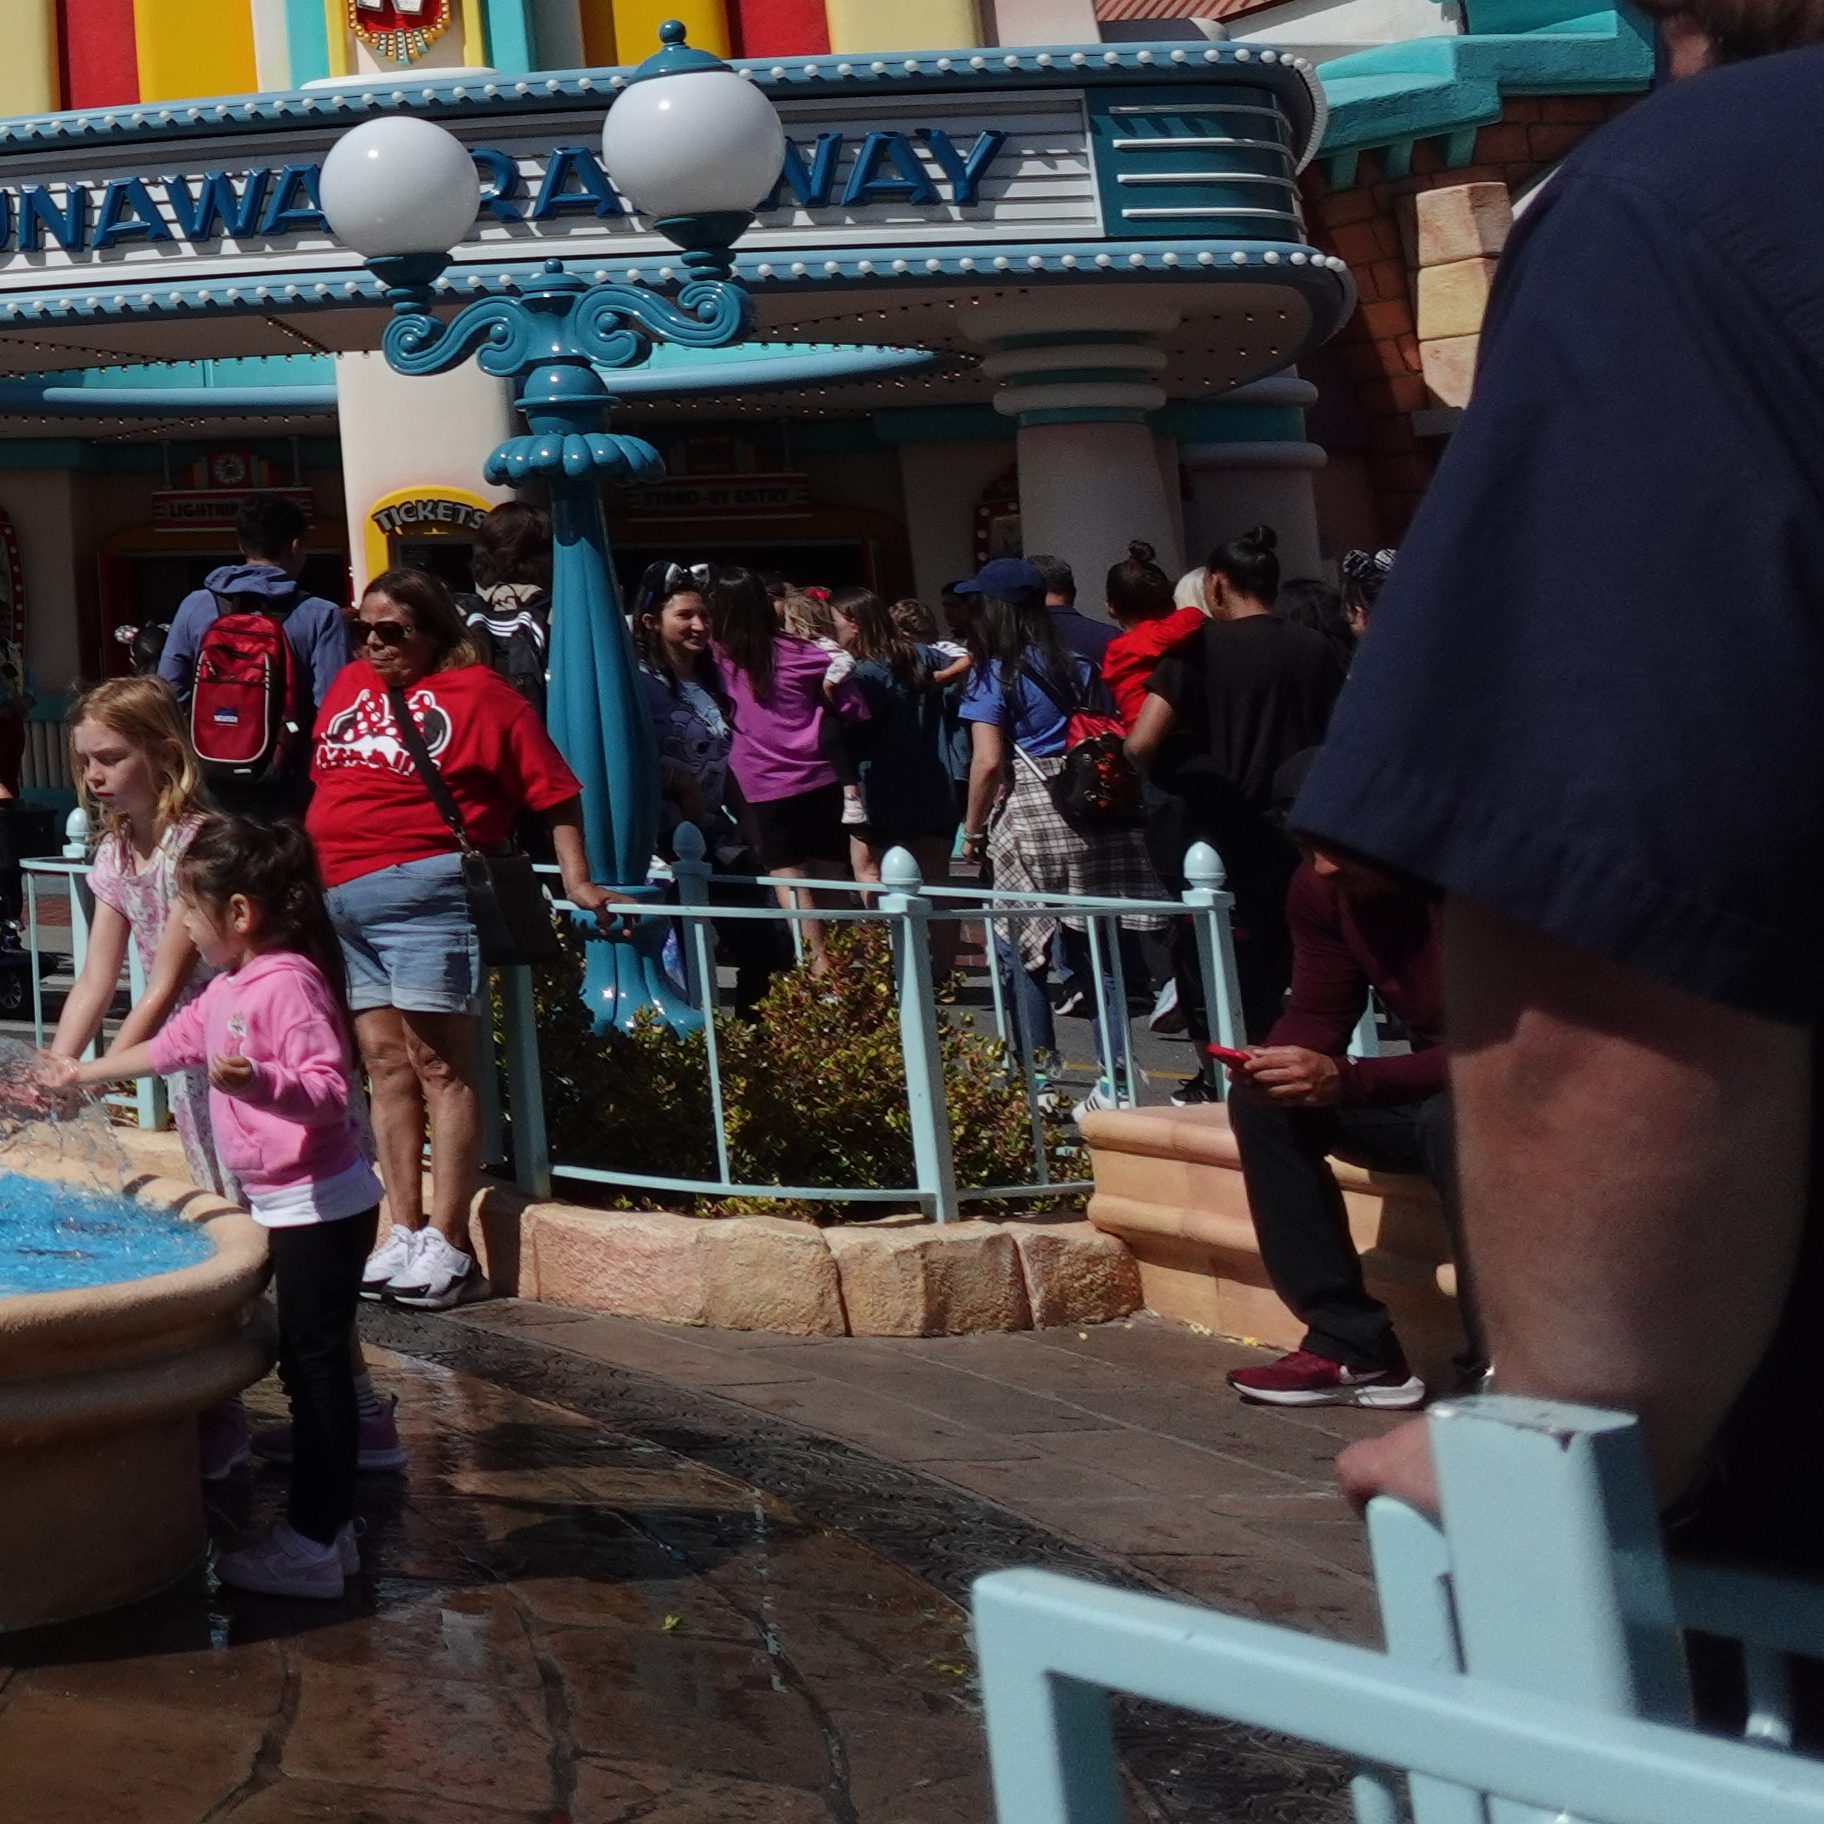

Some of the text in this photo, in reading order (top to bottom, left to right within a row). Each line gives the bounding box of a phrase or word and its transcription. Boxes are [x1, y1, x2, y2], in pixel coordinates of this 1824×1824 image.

[470, 129, 1009, 222] RAWAY
[169, 502, 240, 518] LIGHTNIN
[371, 498, 488, 535] TICKETS
